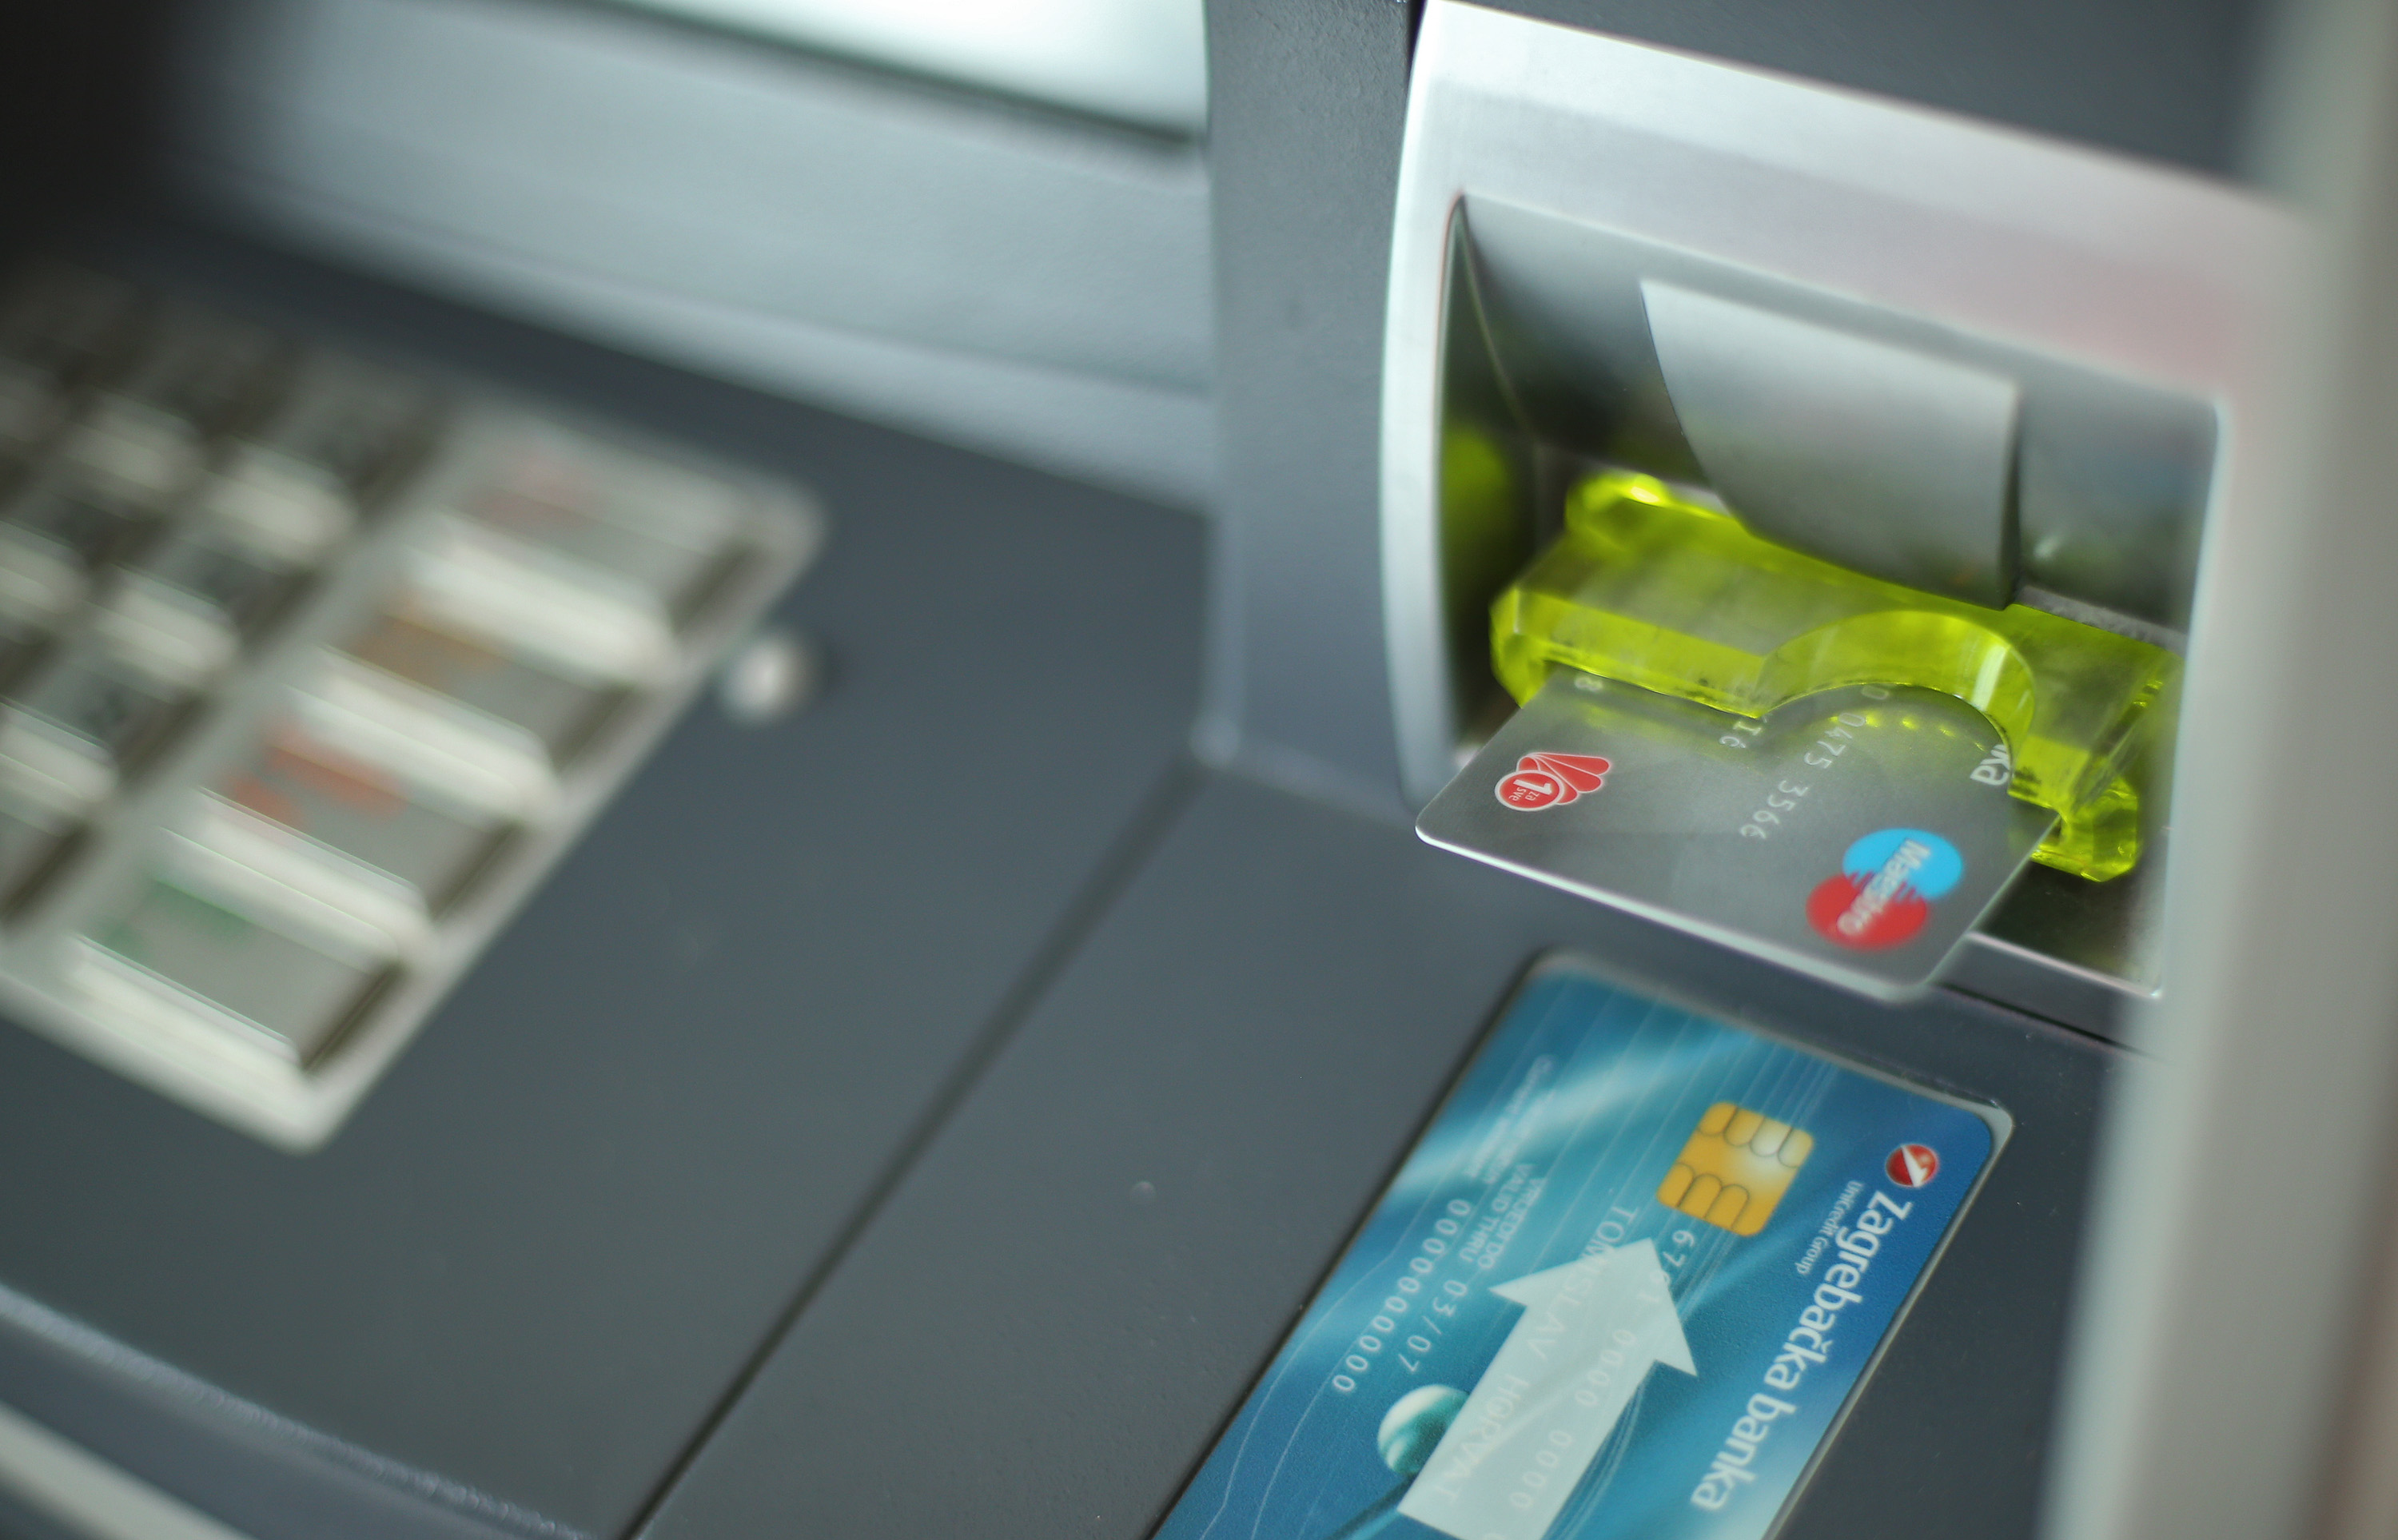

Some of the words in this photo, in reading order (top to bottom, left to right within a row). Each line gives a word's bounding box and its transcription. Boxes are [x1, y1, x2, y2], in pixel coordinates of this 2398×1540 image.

[1803, 712, 1866, 770] 0475
[1508, 787, 1526, 802] sve
[1513, 779, 1552, 795] 1
[1525, 791, 1540, 801] za
[1739, 780, 1809, 839] 3566
[1836, 839, 1931, 936] Maestro
[1460, 1216, 1500, 1263] THRU
[1818, 1180, 1863, 1240] UniCredit
[1478, 1242, 1504, 1269] DO
[1527, 1205, 1639, 1360] TOMISLAV
[1795, 1236, 1830, 1275] Group
[1332, 1199, 1472, 1394] 0000000000
[1763, 1190, 1913, 1391] Zagrebačka
[1398, 1279, 1468, 1374] 03/07
[1574, 1328, 1637, 1407] 0000
[1433, 1374, 1530, 1505] HORVAT
[1510, 1430, 1573, 1509] 0000
[1689, 1392, 1798, 1510] banka
